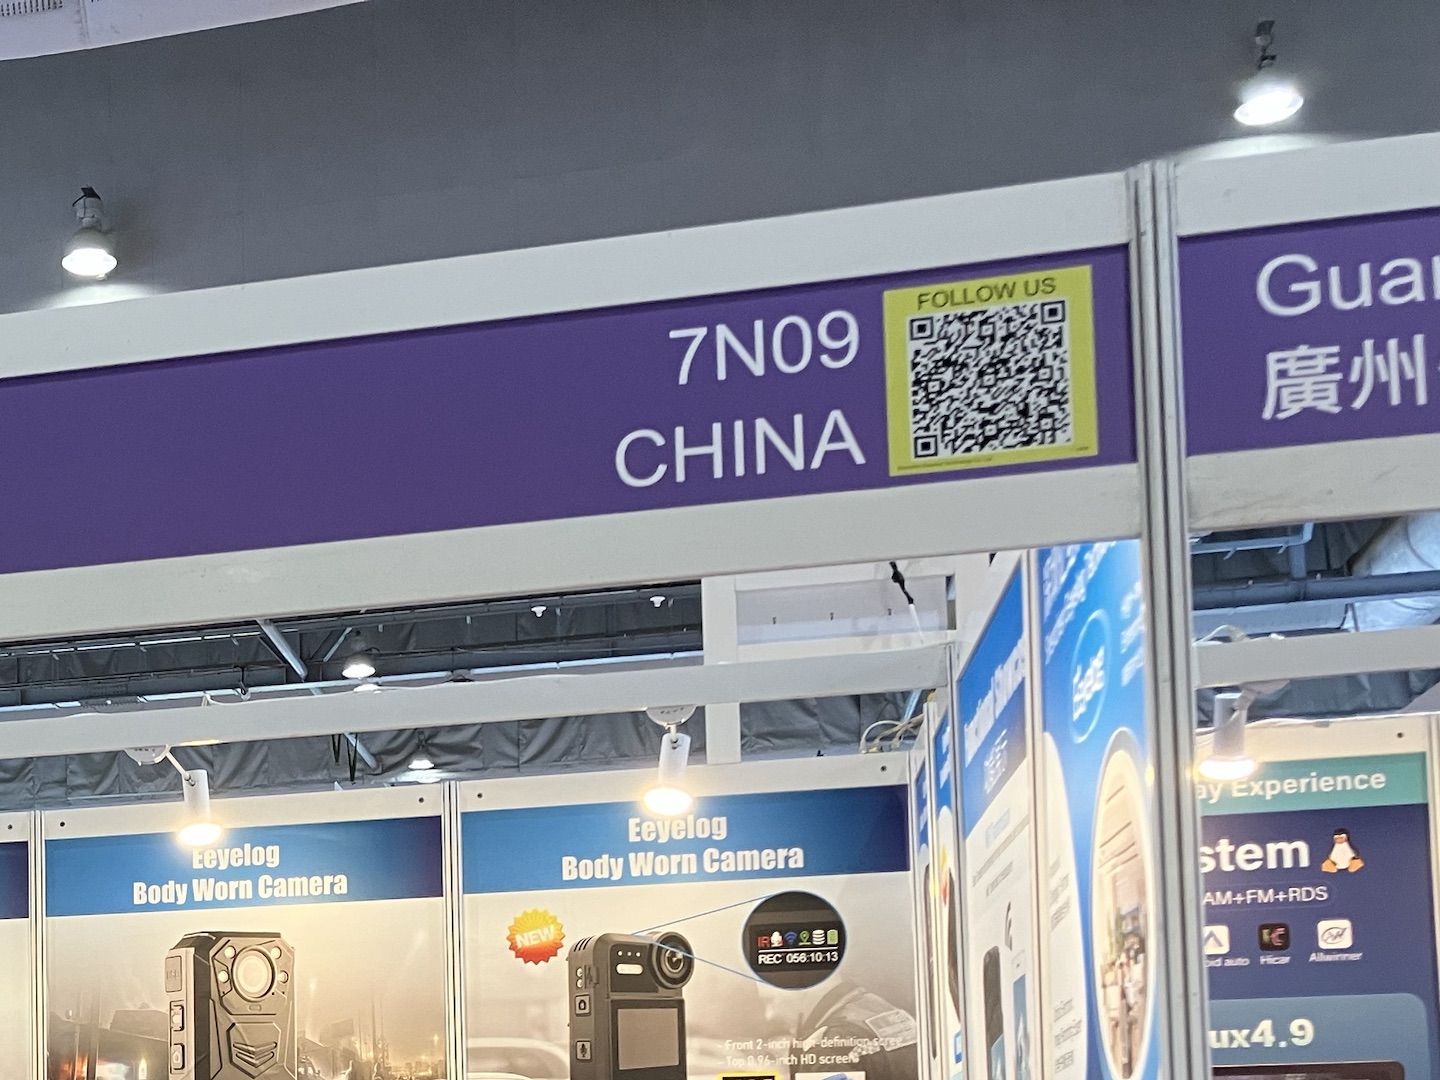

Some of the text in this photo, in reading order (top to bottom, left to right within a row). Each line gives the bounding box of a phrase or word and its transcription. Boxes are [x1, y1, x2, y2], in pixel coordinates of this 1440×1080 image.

[917, 277, 1056, 310] FOLLOW US
[669, 311, 860, 386] 7N09
[1262, 334, 1440, 420] 廣州
[614, 409, 867, 488] CHINA
[1231, 772, 1386, 800] Experience
[628, 814, 727, 844] Eeyelog
[192, 843, 280, 869] Eeyelog
[561, 846, 805, 882] Body Worn Camera
[133, 873, 348, 906] Body Worn Camera
[515, 923, 555, 948] NEW
[758, 954, 782, 965] REC
